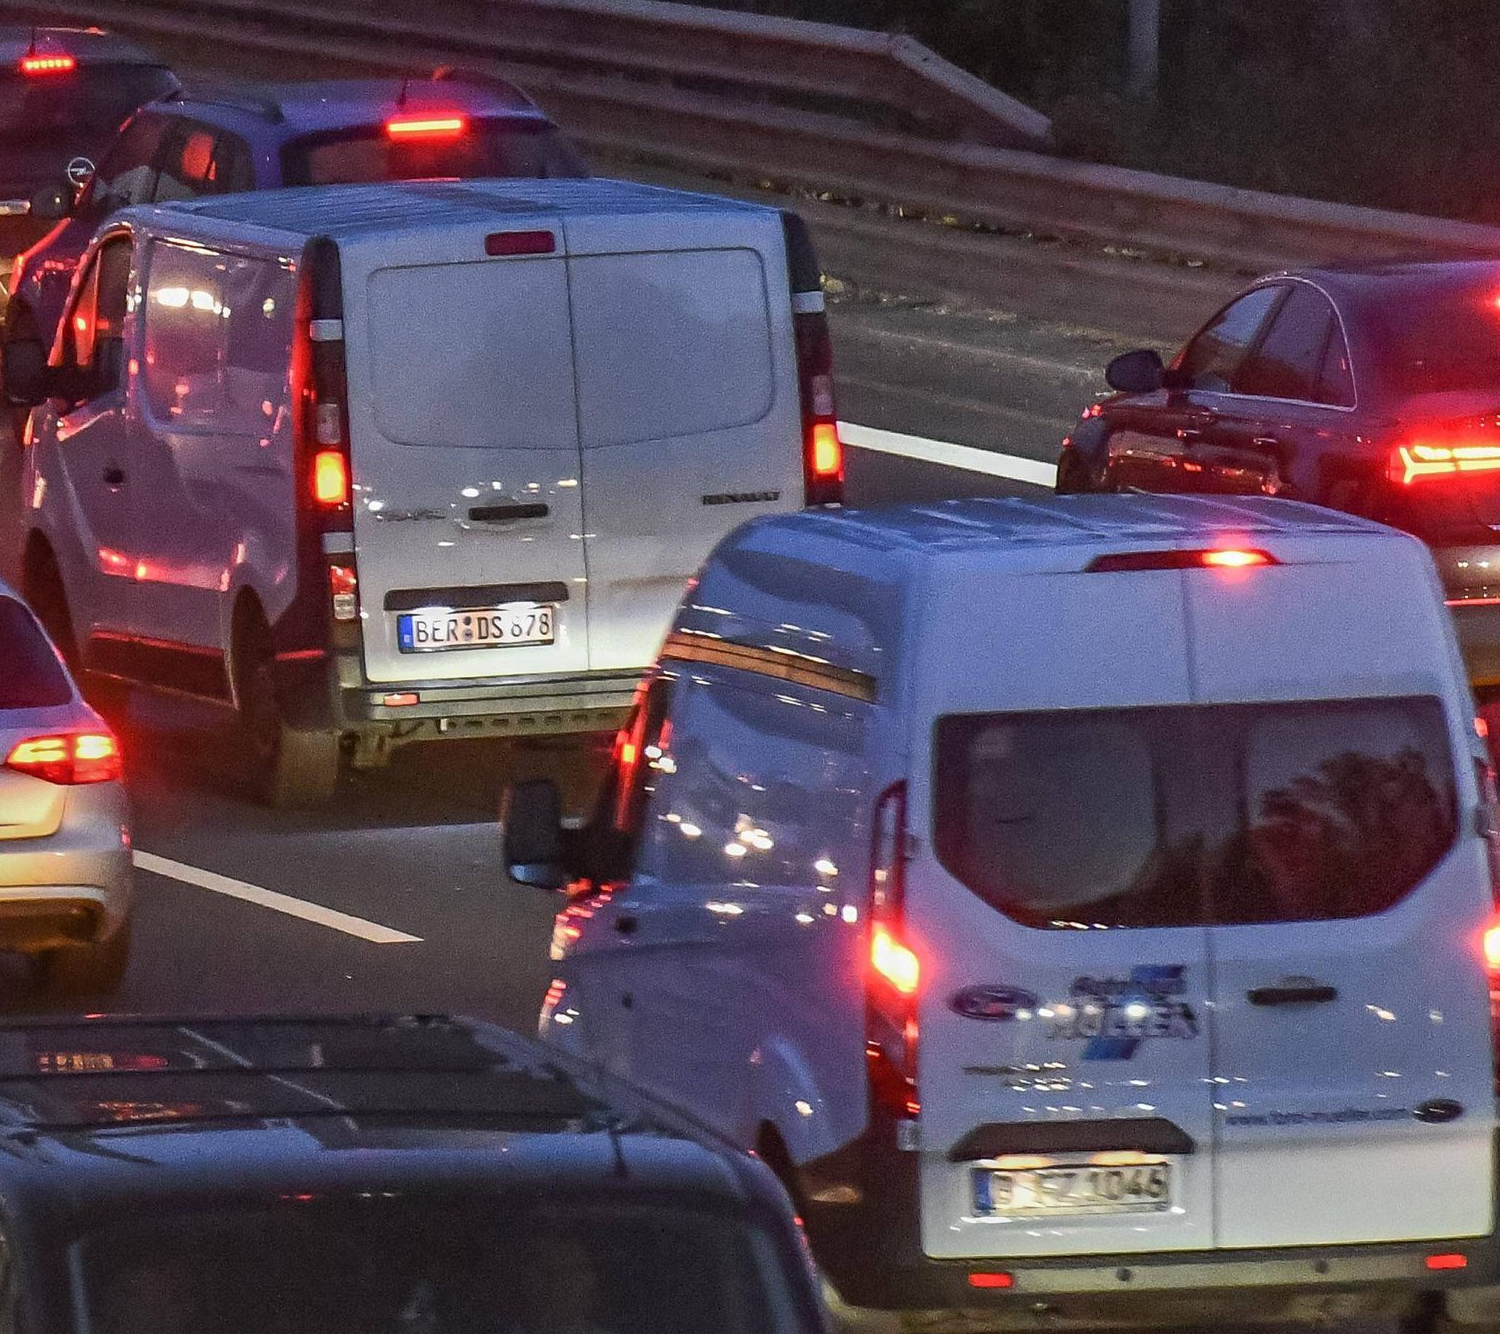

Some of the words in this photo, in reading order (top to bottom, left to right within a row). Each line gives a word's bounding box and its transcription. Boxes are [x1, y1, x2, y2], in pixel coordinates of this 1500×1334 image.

[415, 618, 459, 644] BER
[477, 616, 504, 641] DS
[510, 613, 550, 638] 878
